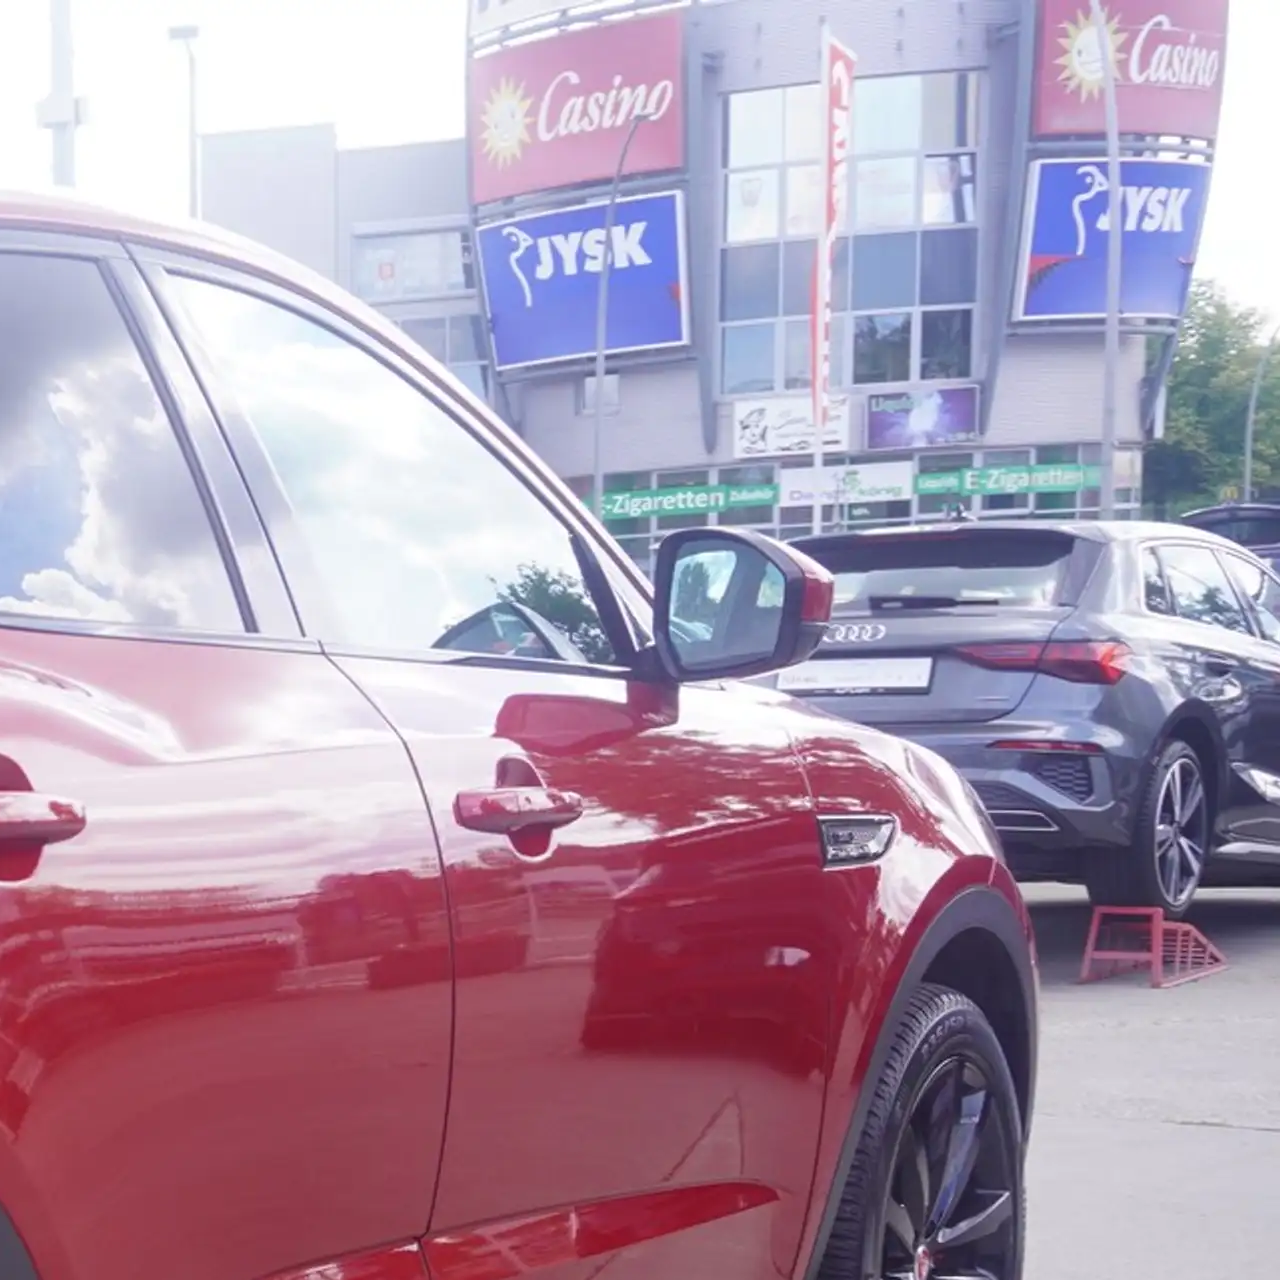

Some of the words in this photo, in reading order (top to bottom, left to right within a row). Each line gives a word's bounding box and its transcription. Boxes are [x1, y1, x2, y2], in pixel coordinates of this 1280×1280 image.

[1129, 14, 1219, 87] Casino
[537, 71, 673, 141] Casino
[535, 221, 653, 280] JYSK
